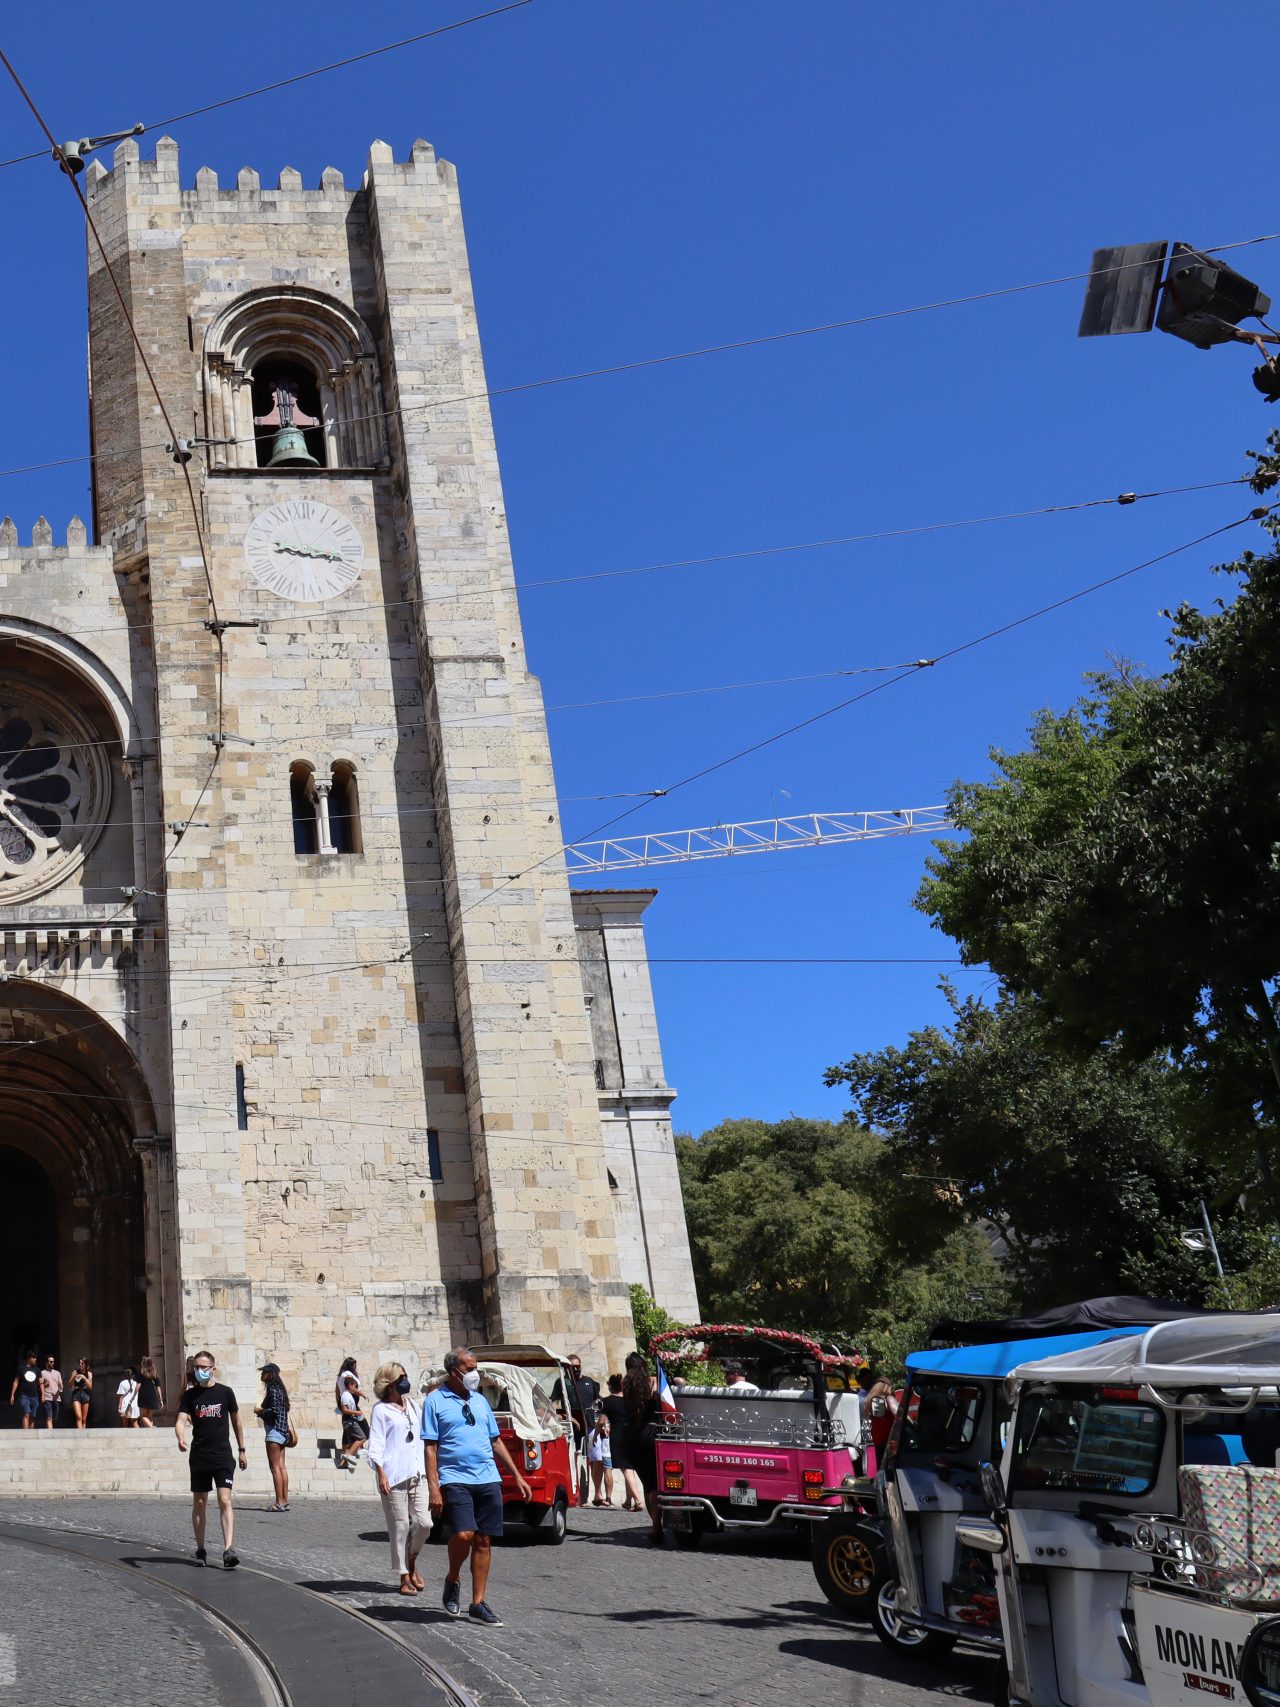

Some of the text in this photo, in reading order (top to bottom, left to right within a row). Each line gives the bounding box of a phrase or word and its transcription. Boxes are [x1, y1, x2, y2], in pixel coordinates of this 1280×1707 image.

[703, 1454, 775, 1467] +351 918 160 165
[1154, 1624, 1207, 1673] MON
[1199, 1677, 1220, 1693] tours
